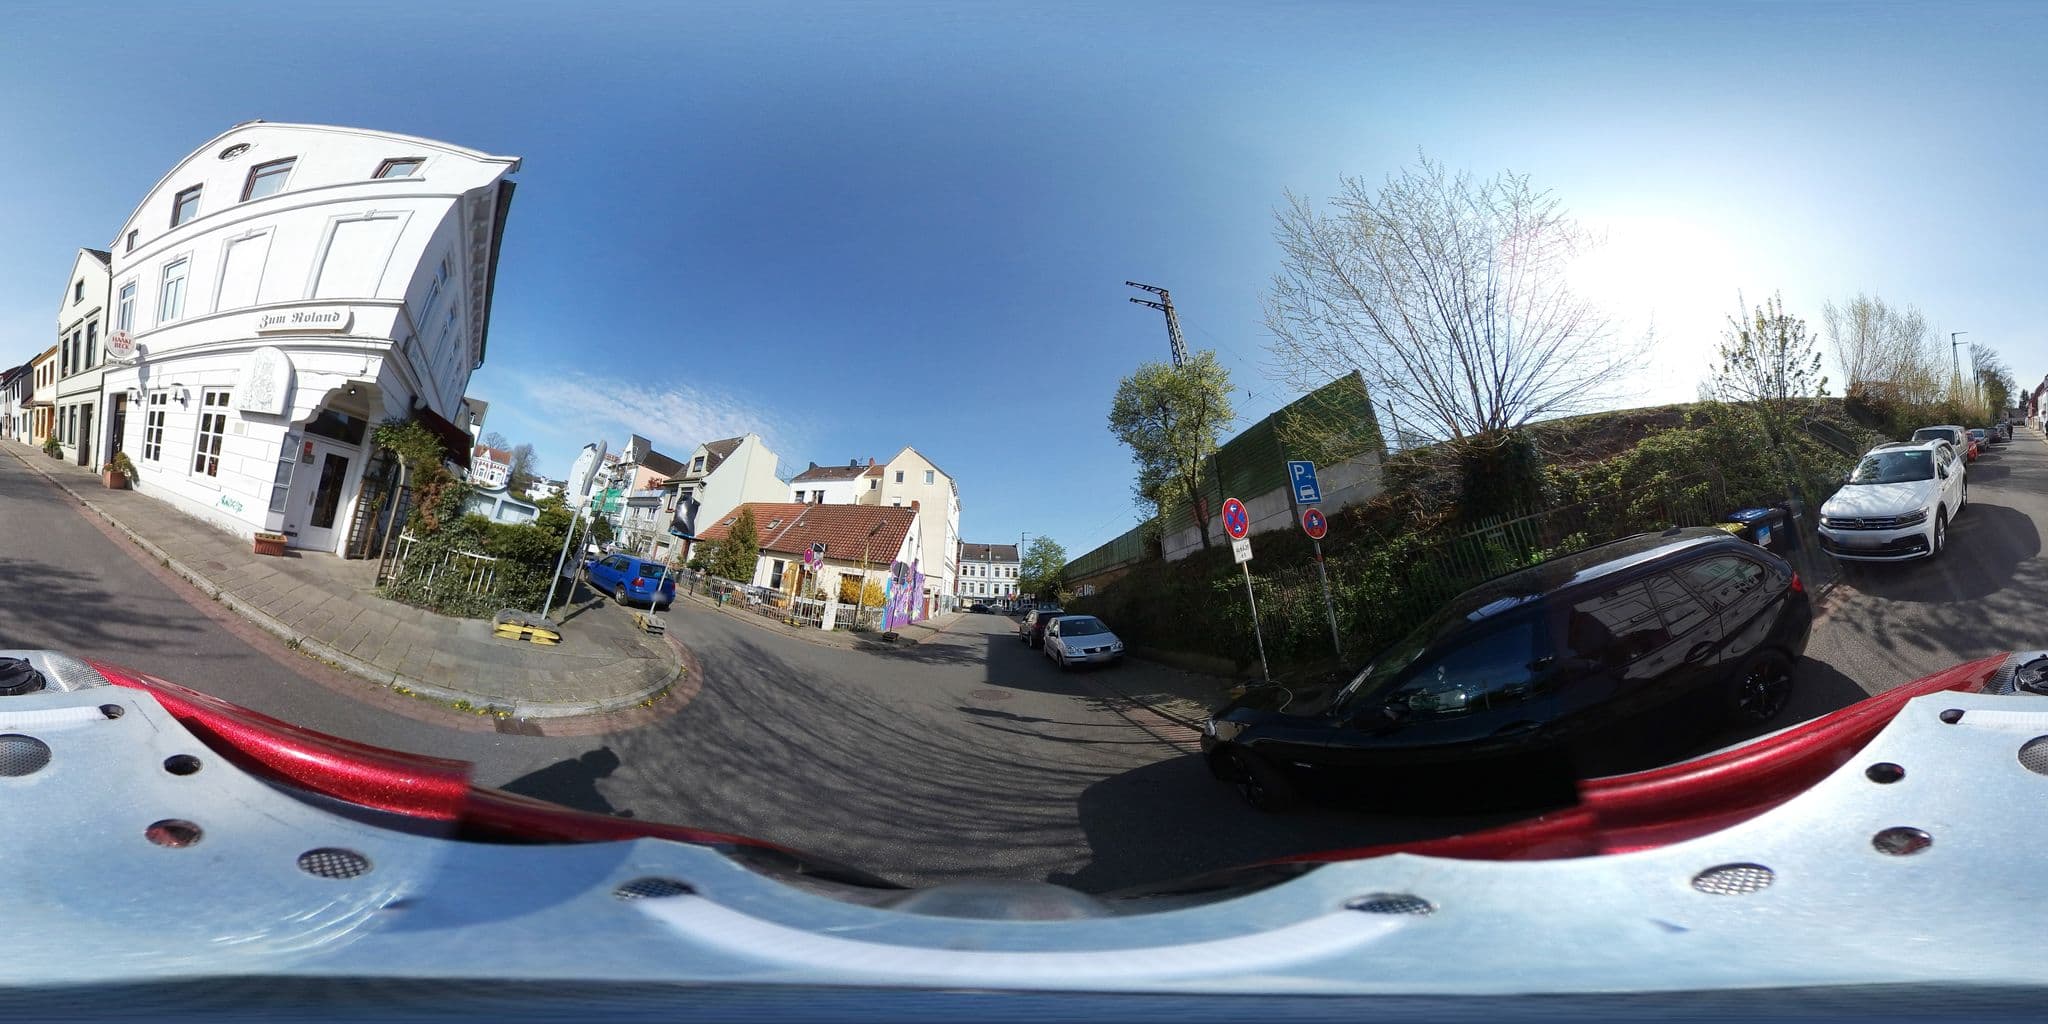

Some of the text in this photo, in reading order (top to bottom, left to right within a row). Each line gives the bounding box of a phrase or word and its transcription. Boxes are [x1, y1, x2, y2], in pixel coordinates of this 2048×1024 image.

[259, 312, 340, 328] Zum Roland
[1294, 464, 1305, 480] P
